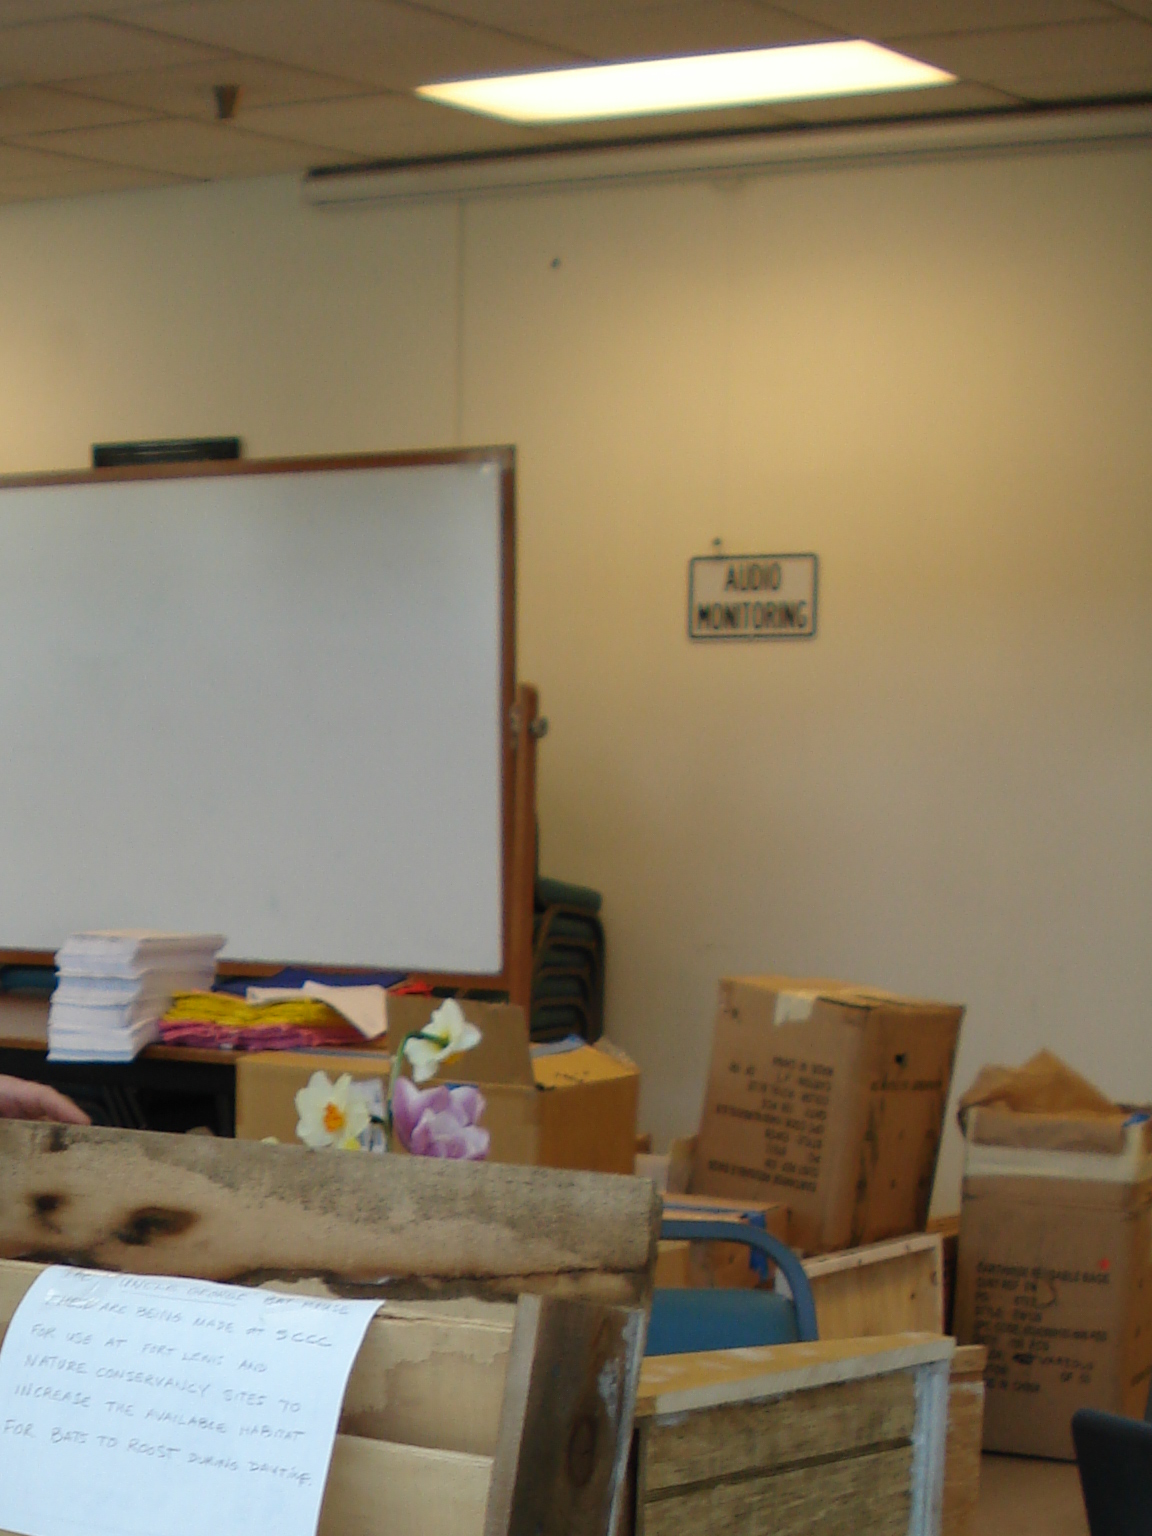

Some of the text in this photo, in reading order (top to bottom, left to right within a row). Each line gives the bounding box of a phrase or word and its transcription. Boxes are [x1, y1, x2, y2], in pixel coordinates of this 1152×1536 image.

[724, 562, 782, 591] AUDIO
[697, 600, 808, 631] MONITORING
[119, 1278, 176, 1292] UNCLE
[186, 1287, 247, 1301] GEORGE
[301, 1301, 349, 1315] HOUSE
[31, 1323, 57, 1340] FOR
[66, 1332, 94, 1346] USE
[104, 1337, 128, 1348] AT
[142, 1343, 177, 1357] FORT
[238, 1359, 268, 1373] AND
[98, 1302, 127, 1315] ARE
[135, 1307, 182, 1323] BEING
[192, 1317, 235, 1334] MADE
[246, 1327, 266, 1335] AT
[275, 1329, 333, 1347] SCCC
[24, 1354, 302, 1413] NATURE CONSERVANCY SITES TO
[14, 1382, 307, 1441] INCREASE THE AVAILABLE HABITAT
[2, 1419, 36, 1439] FOR
[50, 1426, 90, 1444] BATS
[97, 1435, 119, 1448] TO
[126, 1437, 182, 1459] ROOST
[187, 1452, 240, 1472] DURING
